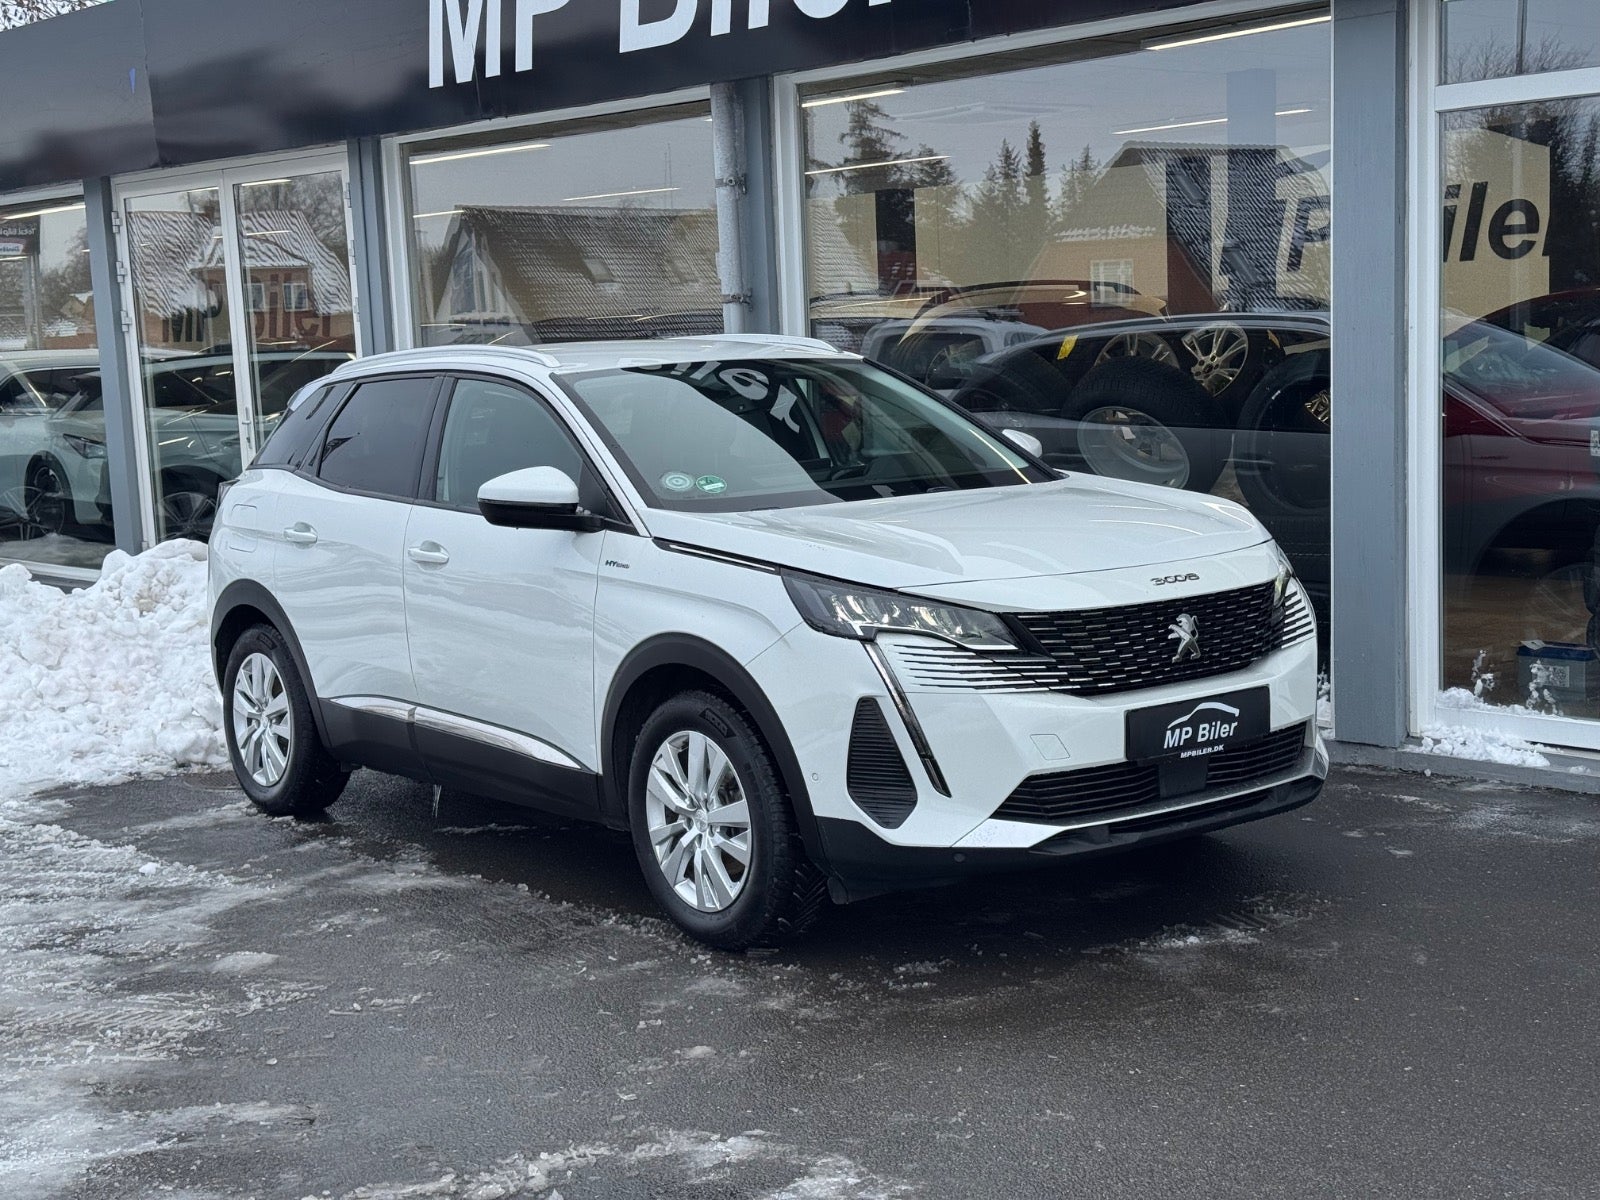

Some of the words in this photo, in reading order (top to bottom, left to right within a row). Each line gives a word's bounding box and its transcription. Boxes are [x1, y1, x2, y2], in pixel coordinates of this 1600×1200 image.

[429, 0, 571, 89] MP
[1151, 572, 1200, 586] 3008
[1163, 726, 1193, 749] MP
[1197, 720, 1239, 742] Biler
[1180, 743, 1225, 758] MPBILER.DK
